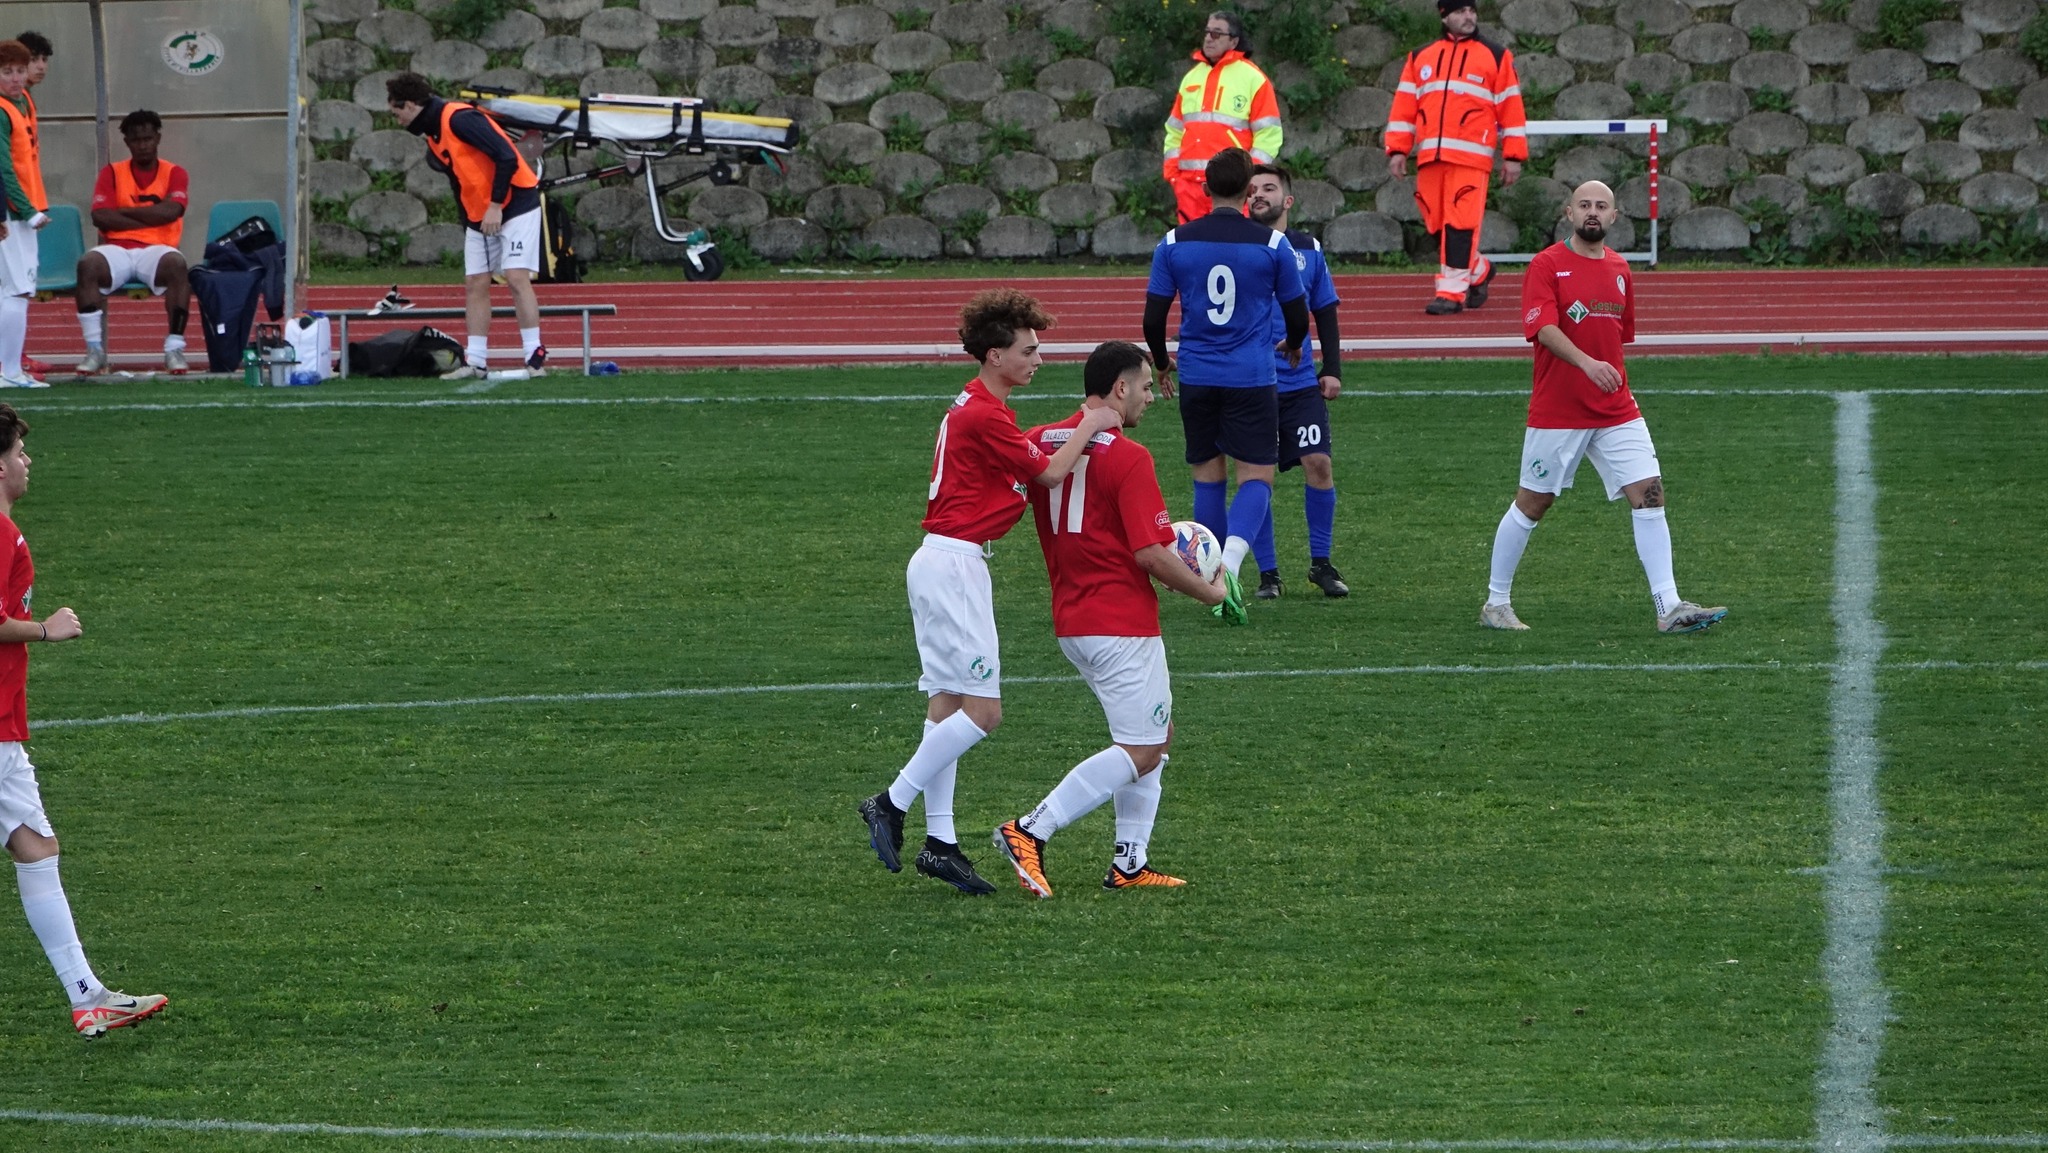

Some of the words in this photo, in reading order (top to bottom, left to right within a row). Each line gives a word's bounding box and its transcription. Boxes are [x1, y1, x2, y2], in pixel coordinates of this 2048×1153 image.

[510, 240, 524, 252] 14
[1206, 264, 1236, 326] 9
[1042, 430, 1073, 441] PALAZZO
[1296, 424, 1322, 448] 20
